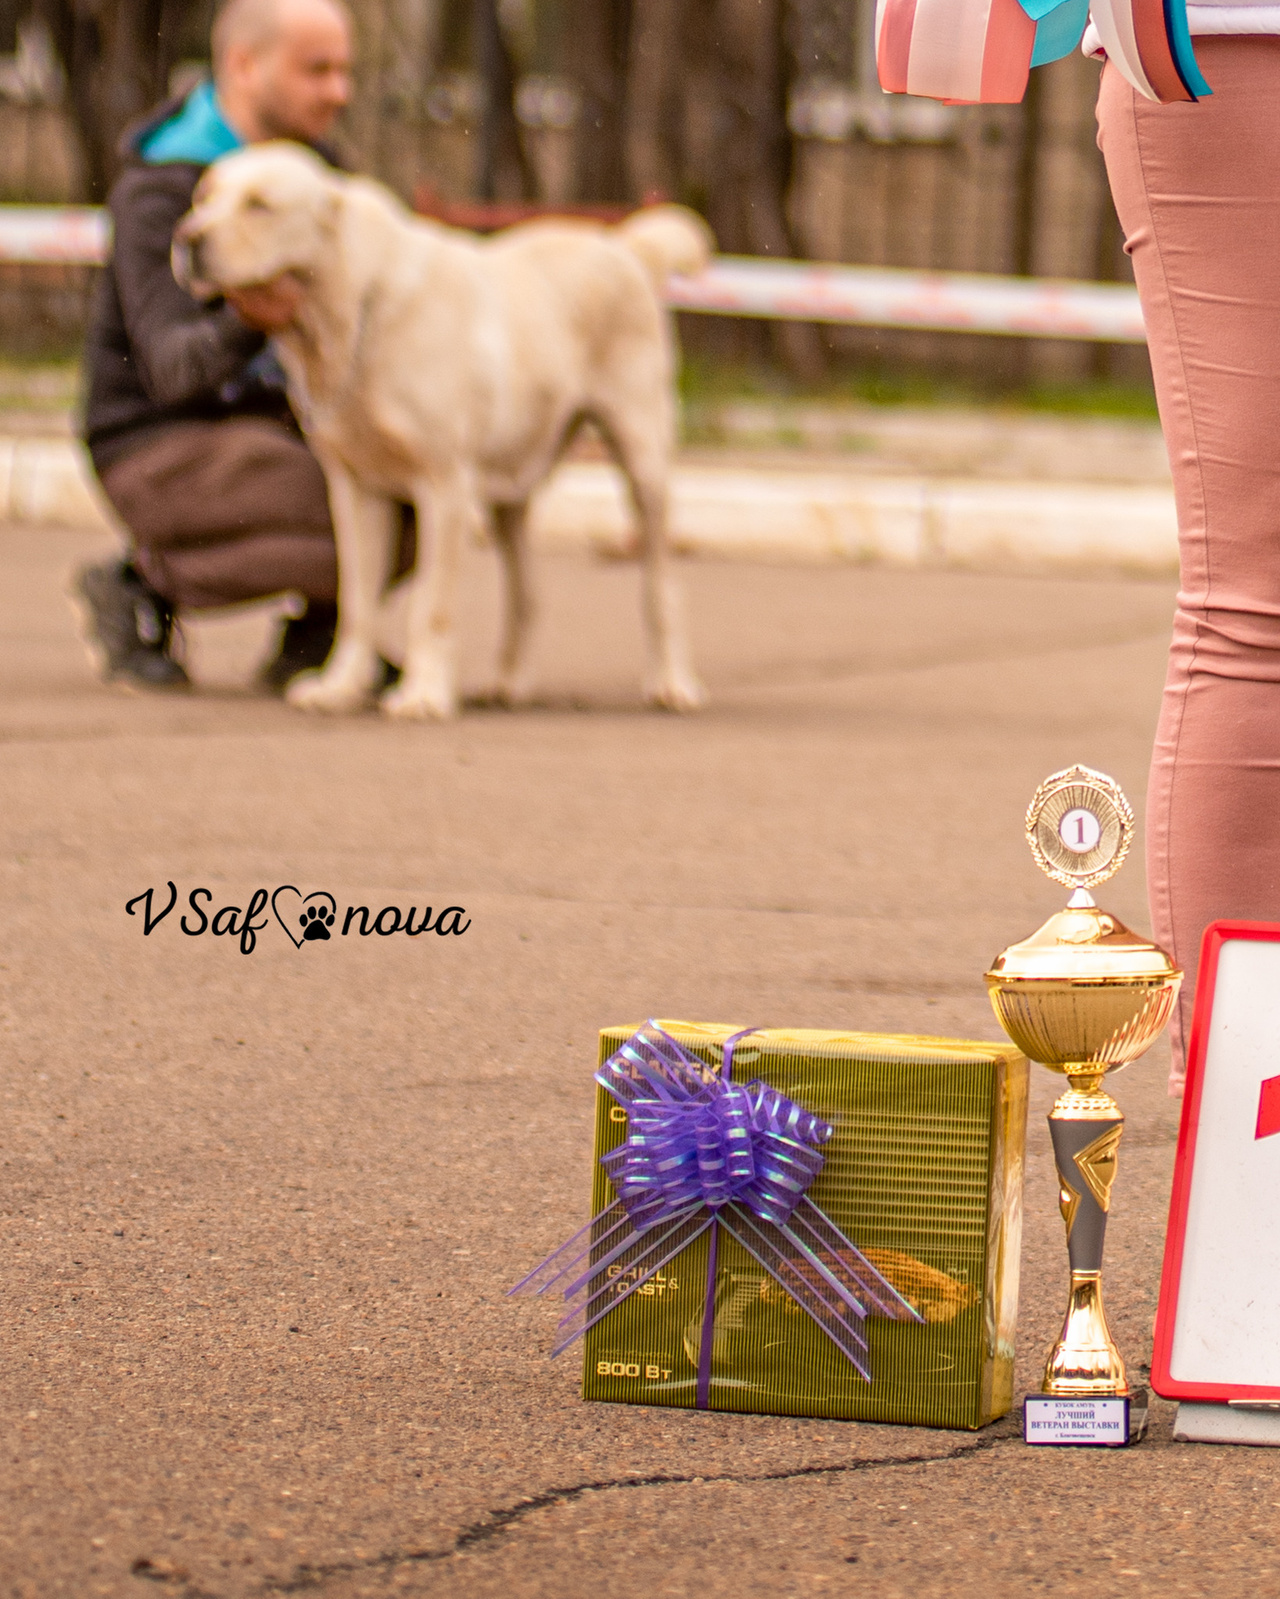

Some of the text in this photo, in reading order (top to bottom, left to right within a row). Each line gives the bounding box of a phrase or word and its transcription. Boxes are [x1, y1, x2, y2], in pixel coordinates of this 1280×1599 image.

[1073, 817, 1086, 845] 1
[596, 1361, 640, 1378] 800
[1055, 1411, 1095, 1420] ЛУЧШИЙ
[1031, 1421, 1119, 1430] ВЕТЕРАН ВЫСТАВКИ
